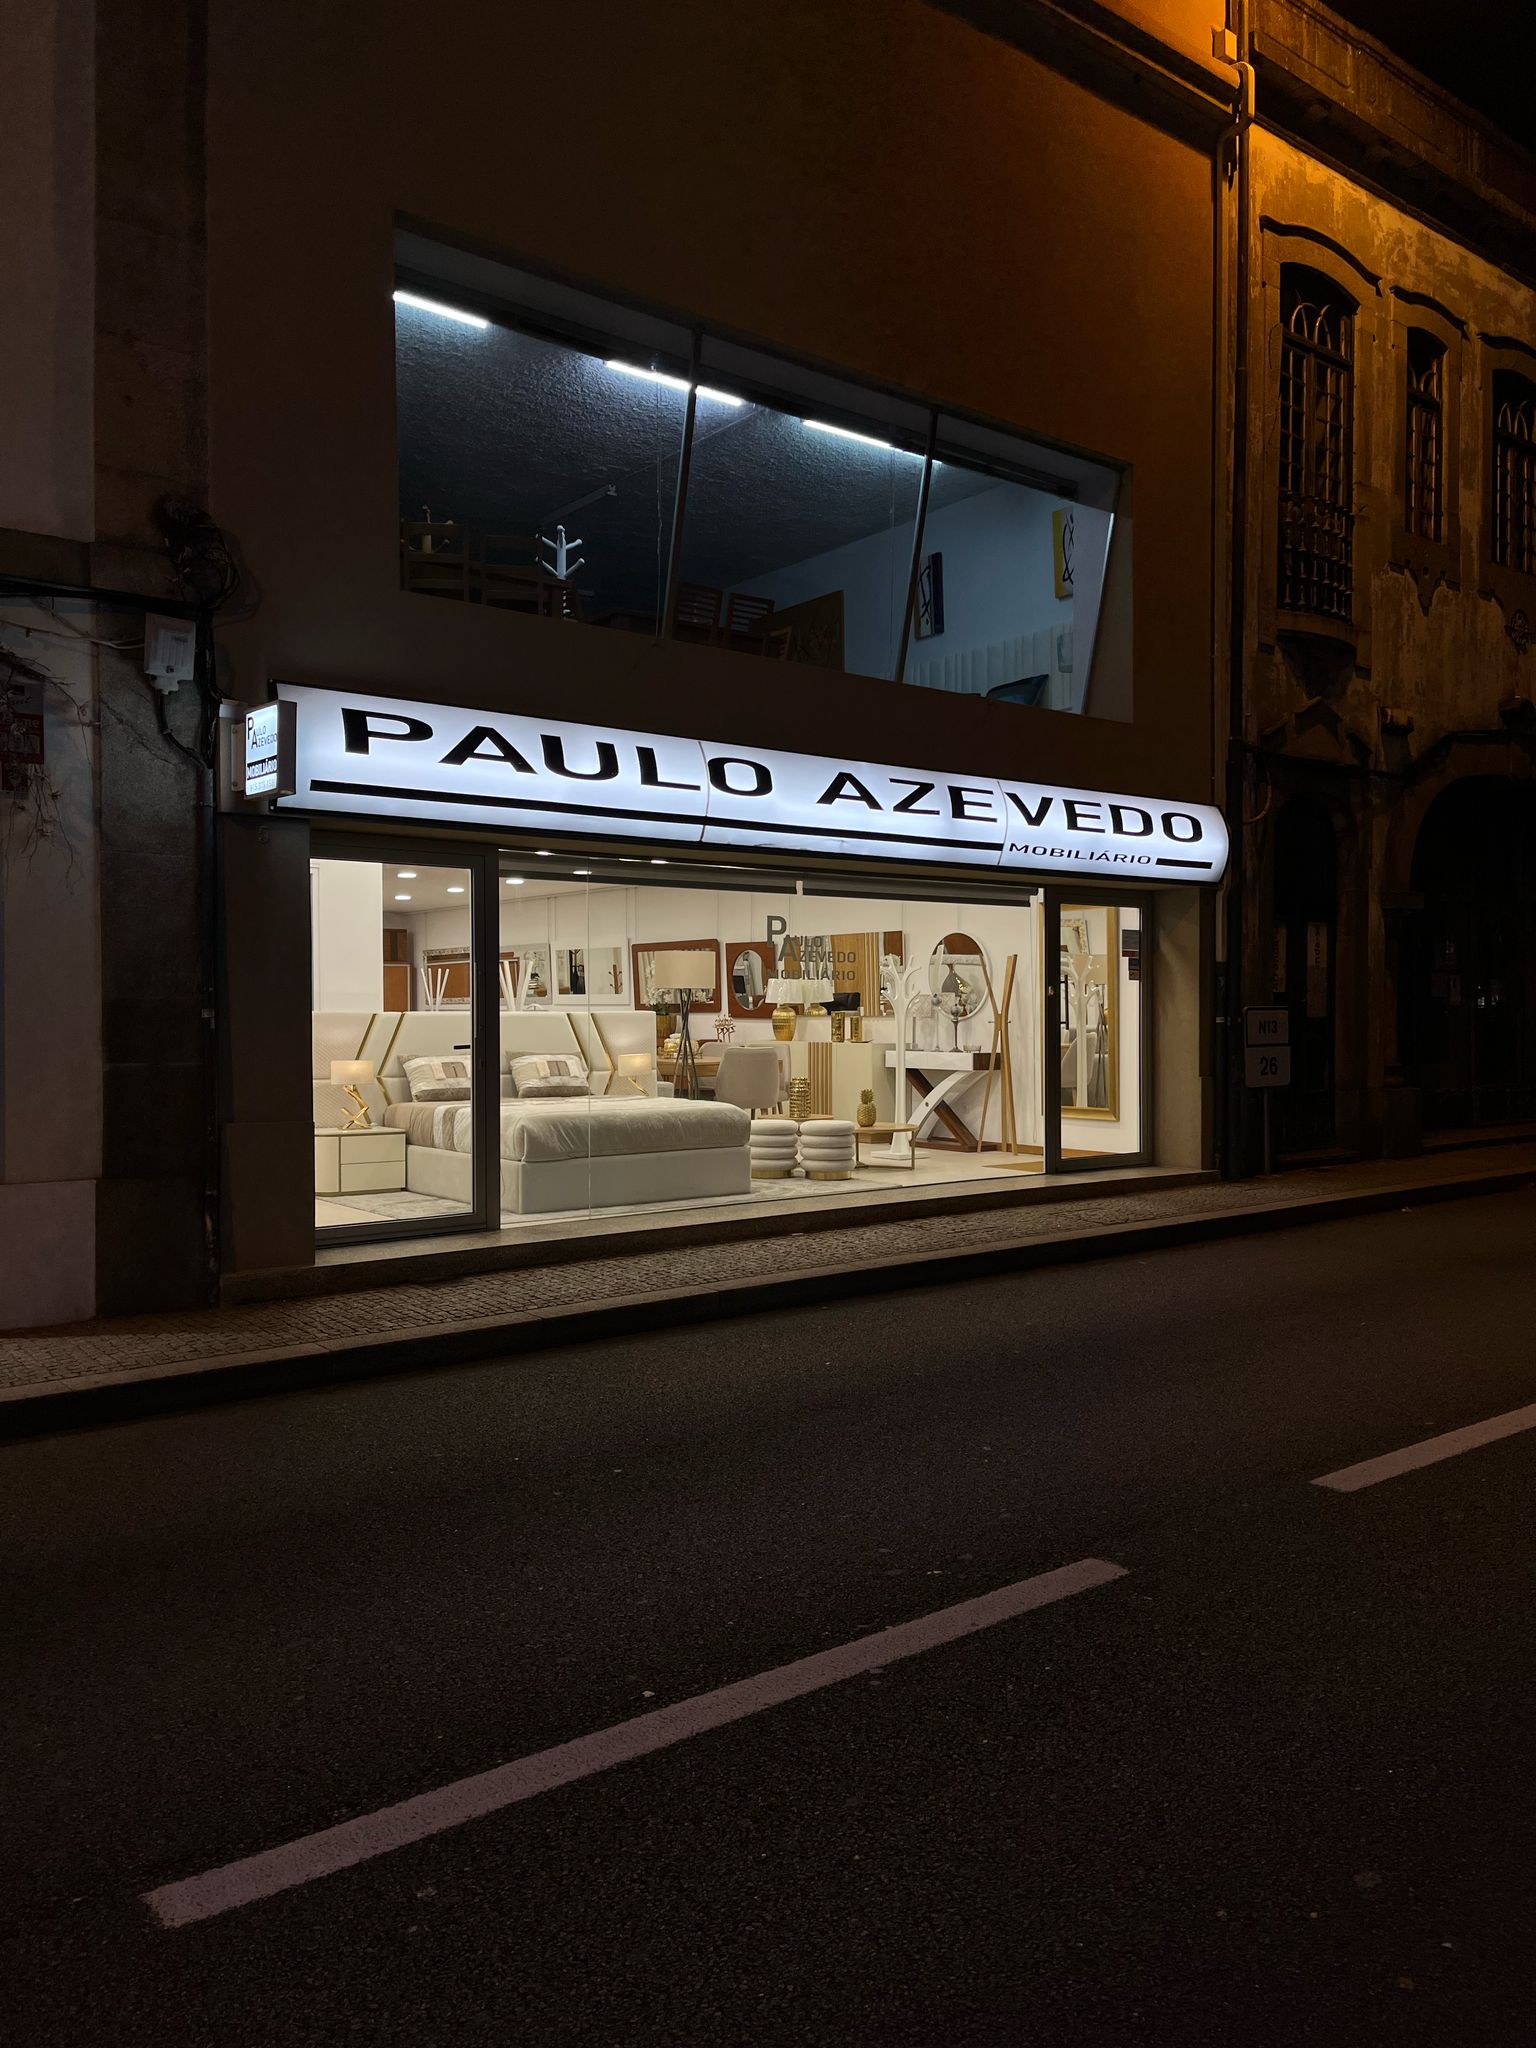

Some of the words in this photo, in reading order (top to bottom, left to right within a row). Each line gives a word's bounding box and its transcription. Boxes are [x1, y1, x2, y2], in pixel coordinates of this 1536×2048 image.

[251, 728, 278, 750] AZEVEDO
[247, 758, 278, 777] MOBILIÁRIO
[341, 707, 773, 797] PAULO
[816, 772, 1203, 843] AZEVEDO
[1008, 842, 1152, 866] MOBILIÁRIO
[767, 915, 823, 948] PAULO
[778, 934, 856, 963] AZEVEDO
[768, 967, 856, 981] MOBILIÁRIO
[1259, 1055, 1278, 1076] 26
